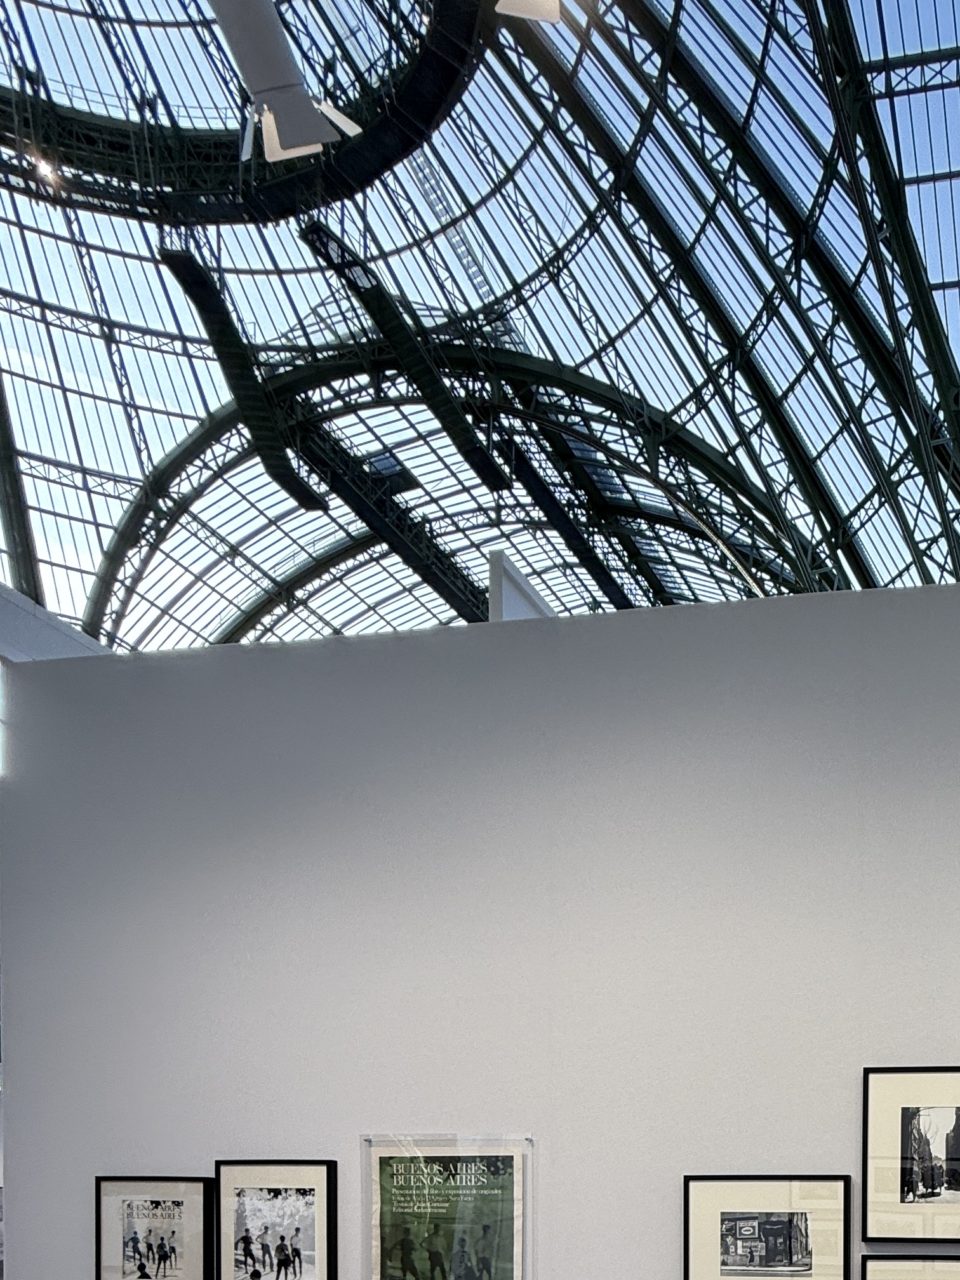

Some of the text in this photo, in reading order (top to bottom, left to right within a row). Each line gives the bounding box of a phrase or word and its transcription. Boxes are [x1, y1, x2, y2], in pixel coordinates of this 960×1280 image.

[393, 1162, 488, 1174] BUENOS AIRES
[393, 1174, 488, 1186] BUENOS AIRES
[127, 1211, 183, 1220] BUENOS AIRES
